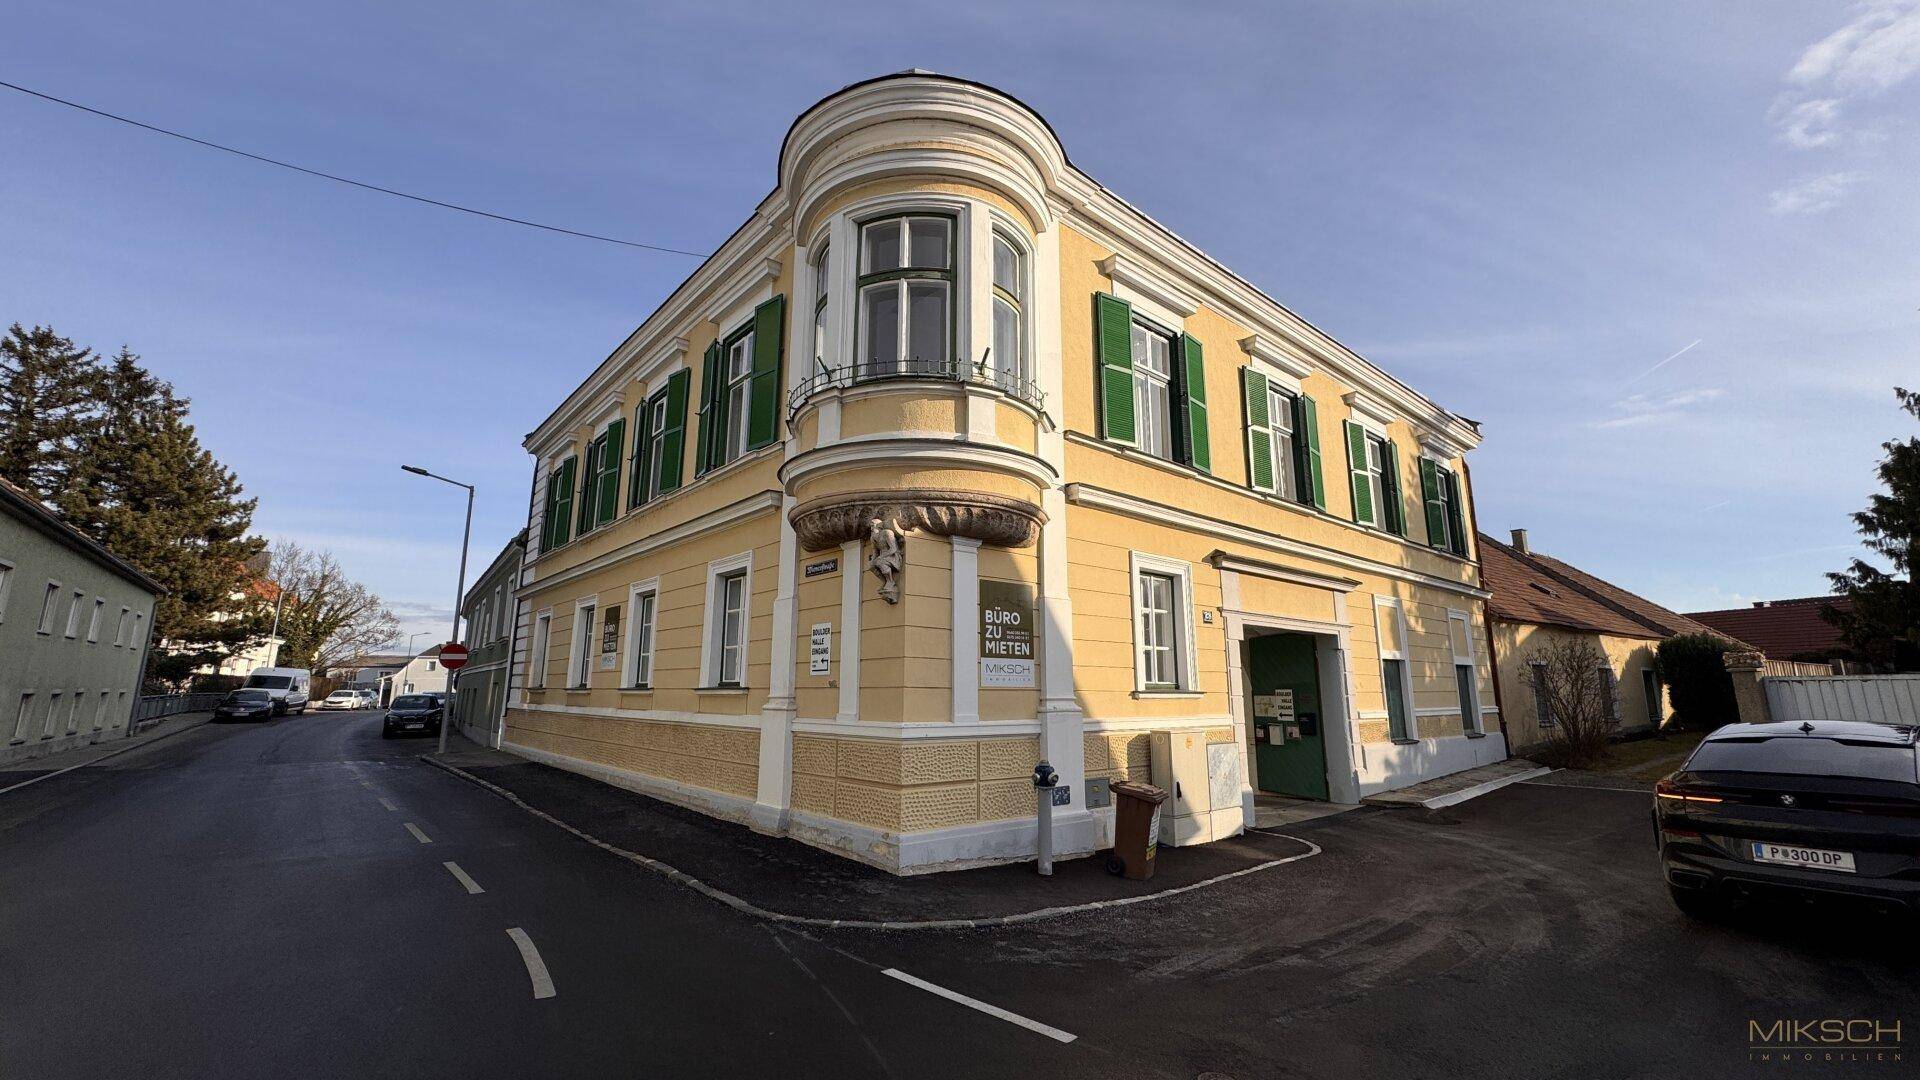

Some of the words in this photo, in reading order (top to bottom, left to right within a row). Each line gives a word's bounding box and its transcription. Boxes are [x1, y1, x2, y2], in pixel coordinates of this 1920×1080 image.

[985, 606, 1021, 625] BÜRO
[812, 628, 831, 636] BOULDER
[985, 624, 1002, 639] ZU
[812, 638, 824, 646] HALLE
[985, 641, 1030, 656] MIETEN
[985, 664, 1031, 675] MIKSCH
[1770, 847, 1780, 858] P
[1791, 849, 1820, 863] 300
[1822, 852, 1842, 865] DP
